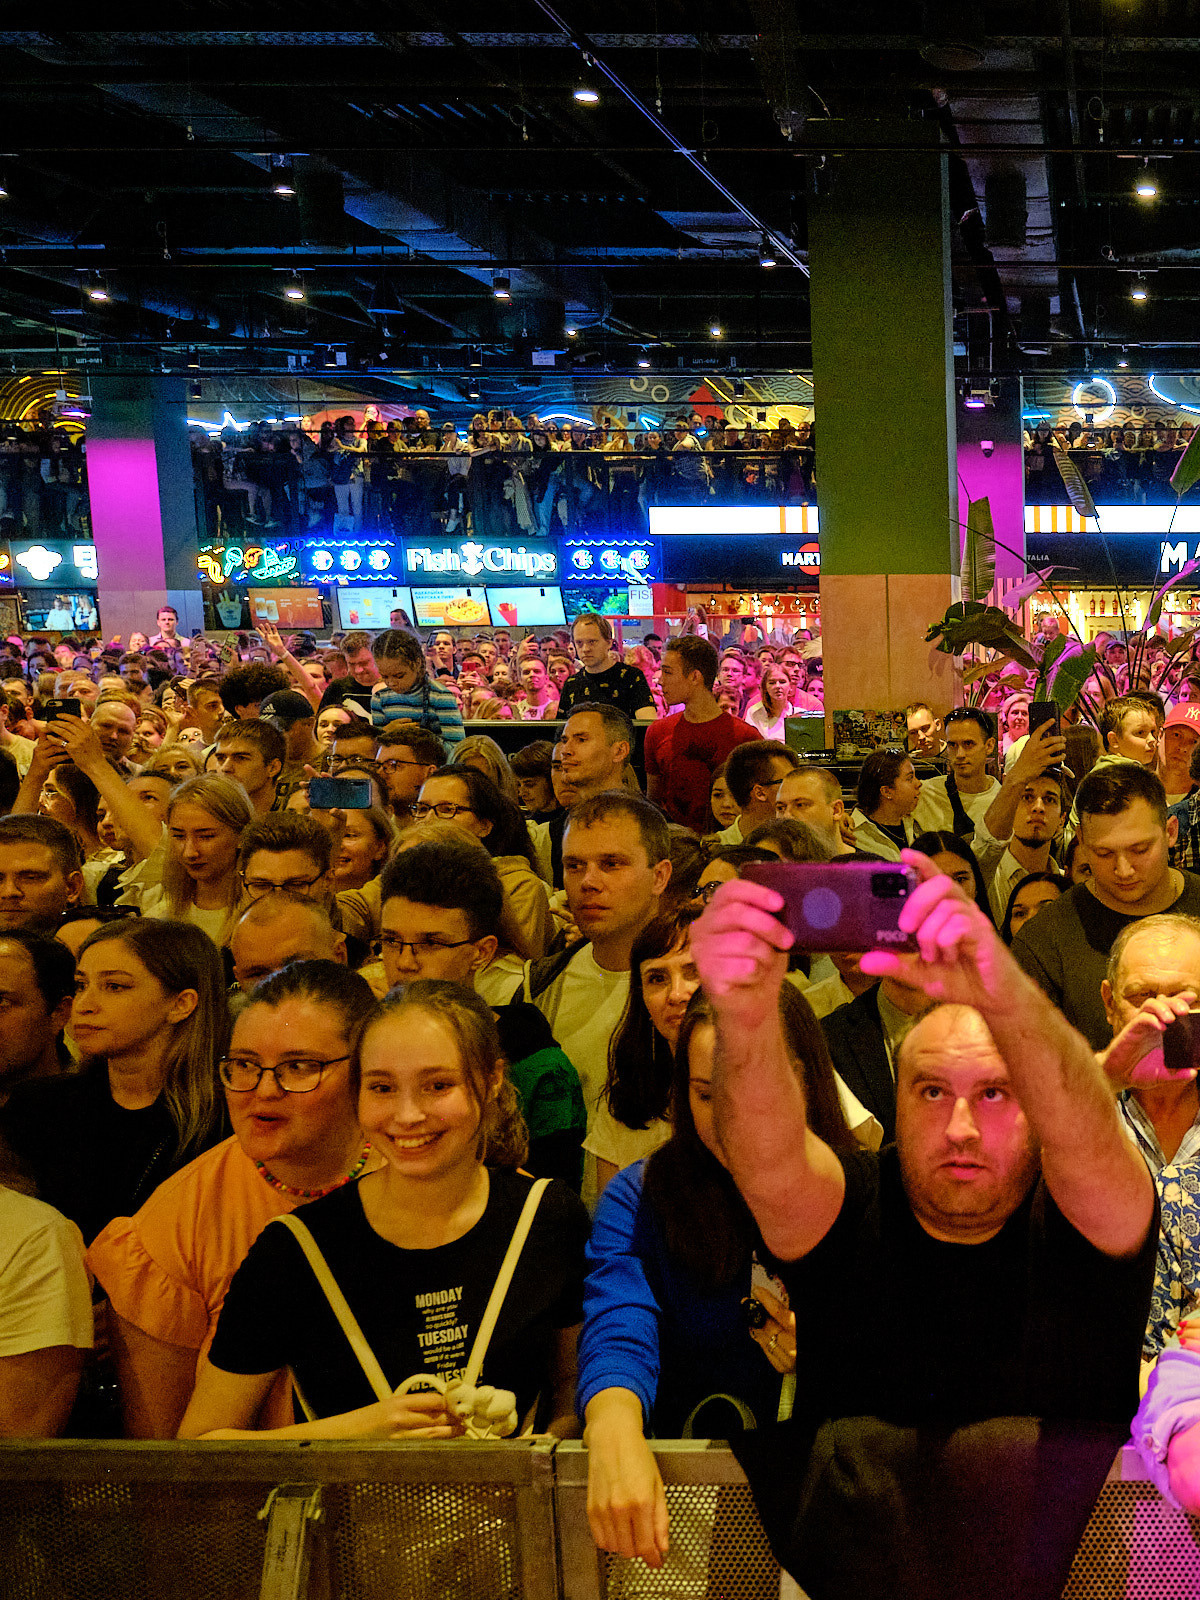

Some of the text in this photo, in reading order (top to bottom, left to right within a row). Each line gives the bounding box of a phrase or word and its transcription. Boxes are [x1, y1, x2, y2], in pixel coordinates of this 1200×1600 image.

[406, 547, 557, 577] Fish Chips
[415, 1286, 463, 1309] MONDAY
[416, 1324, 468, 1348] TUESDAY
